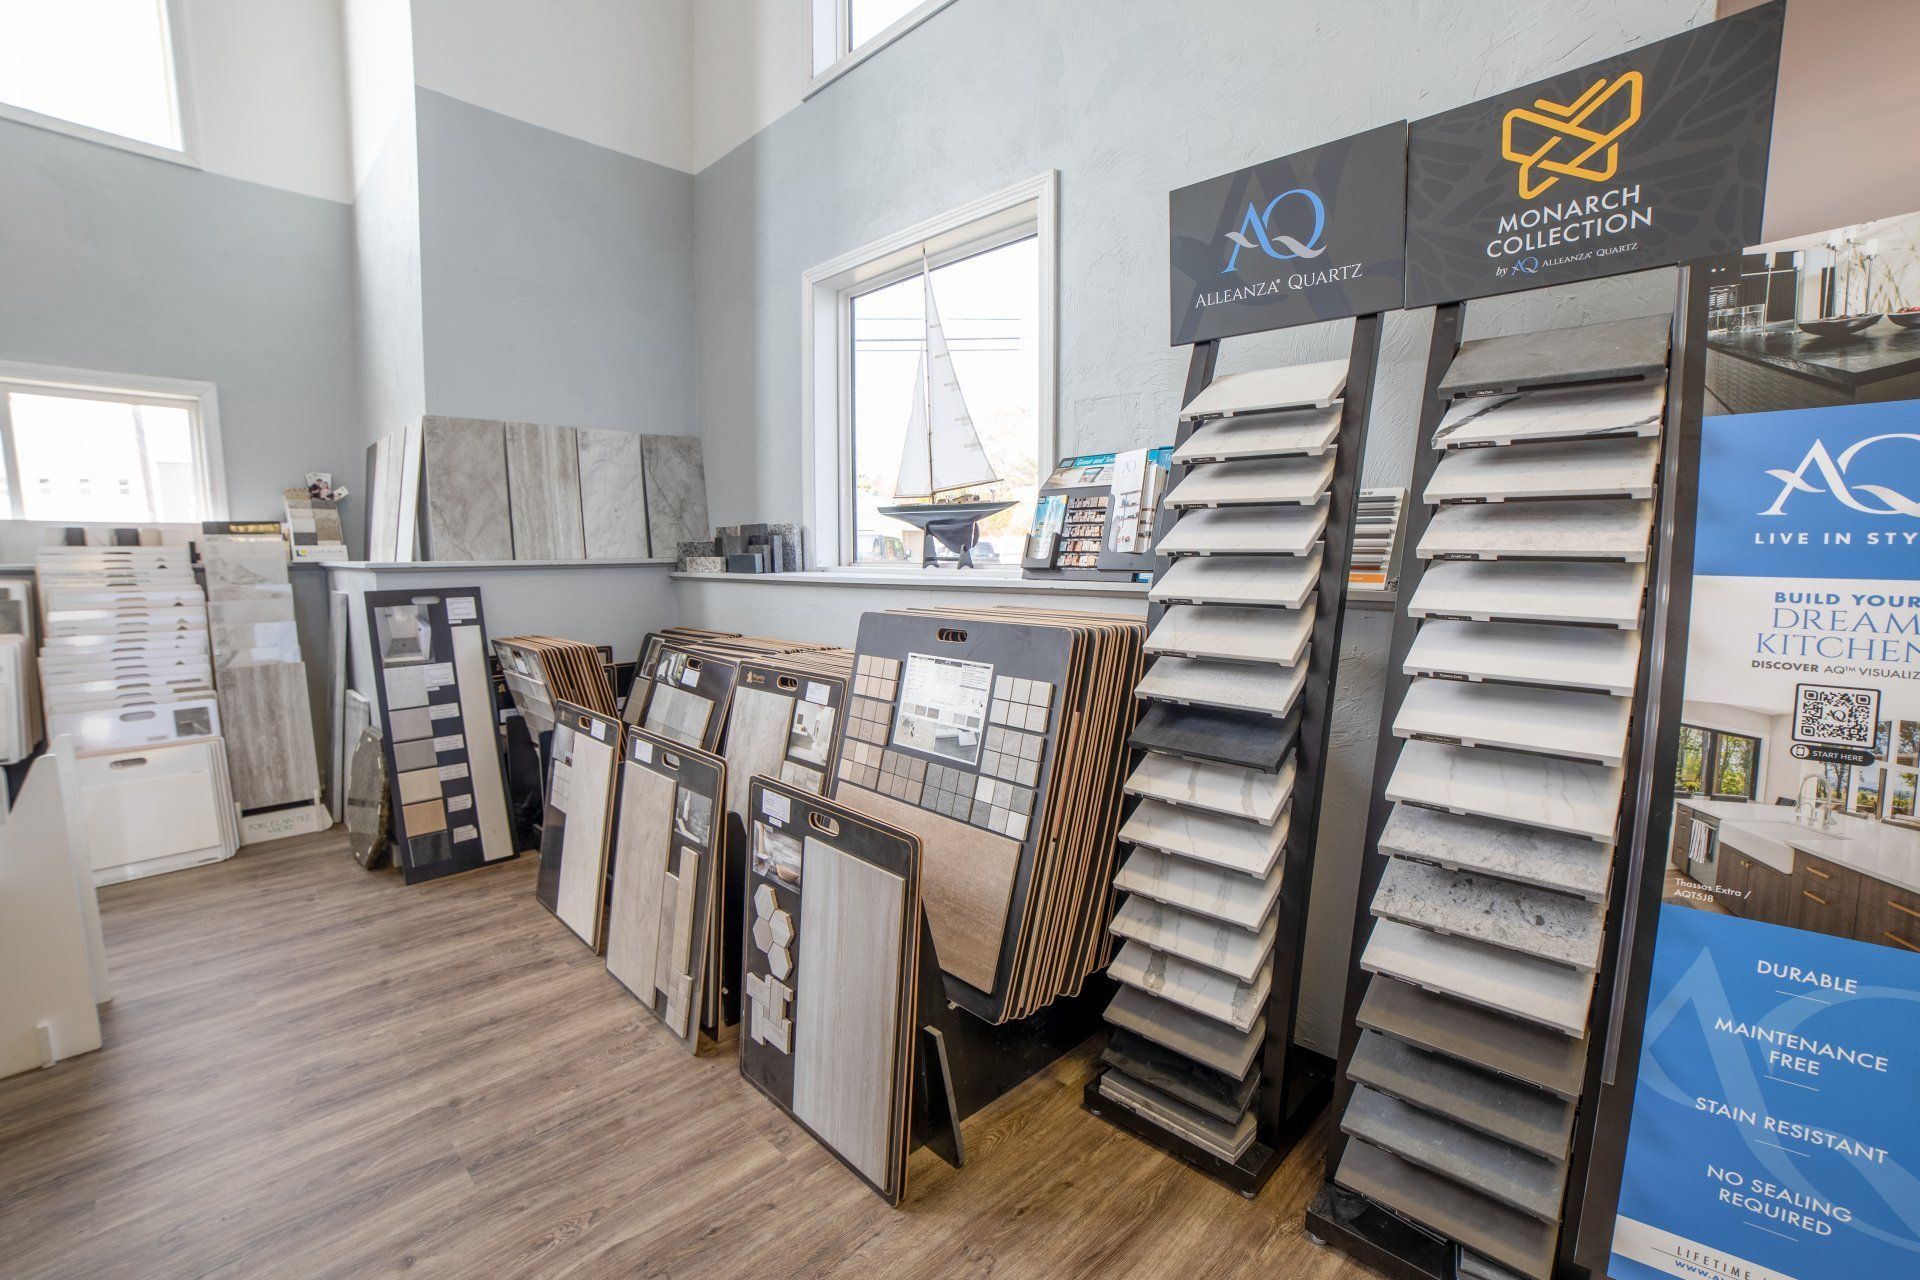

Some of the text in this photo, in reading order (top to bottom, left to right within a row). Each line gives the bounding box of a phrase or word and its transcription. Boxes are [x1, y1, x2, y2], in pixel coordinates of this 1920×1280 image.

[1498, 184, 1640, 234] MONARCH
[1221, 188, 1327, 273] AQ
[1487, 206, 1652, 258] COLLECTION
[1288, 263, 1362, 290] QUARTZ
[1495, 266, 1508, 277] by
[1596, 242, 1638, 257] QUARTZ
[1755, 533, 1808, 544] LIVE
[1823, 533, 1851, 544] IN
[1775, 592, 1920, 608] BUILD YOUR
[1772, 607, 1920, 635] DREAM
[1751, 660, 1819, 673] DISCOVER
[1812, 750, 1863, 762] START HERE
[1673, 889, 1714, 902] AQT5J8
[1675, 878, 1712, 891] Thassos
[1715, 885, 1742, 897] Extra
[1757, 959, 1858, 995] DURABLE
[1714, 1017, 1889, 1072] MAINTENANCE
[1769, 1050, 1820, 1076] FREE
[1695, 1097, 1888, 1164] STAIN RESISTANT
[1707, 1164, 1852, 1222] NO SEALING
[1719, 1188, 1832, 1236] REQUIRED
[1677, 1246, 1751, 1280] LIFETIME
